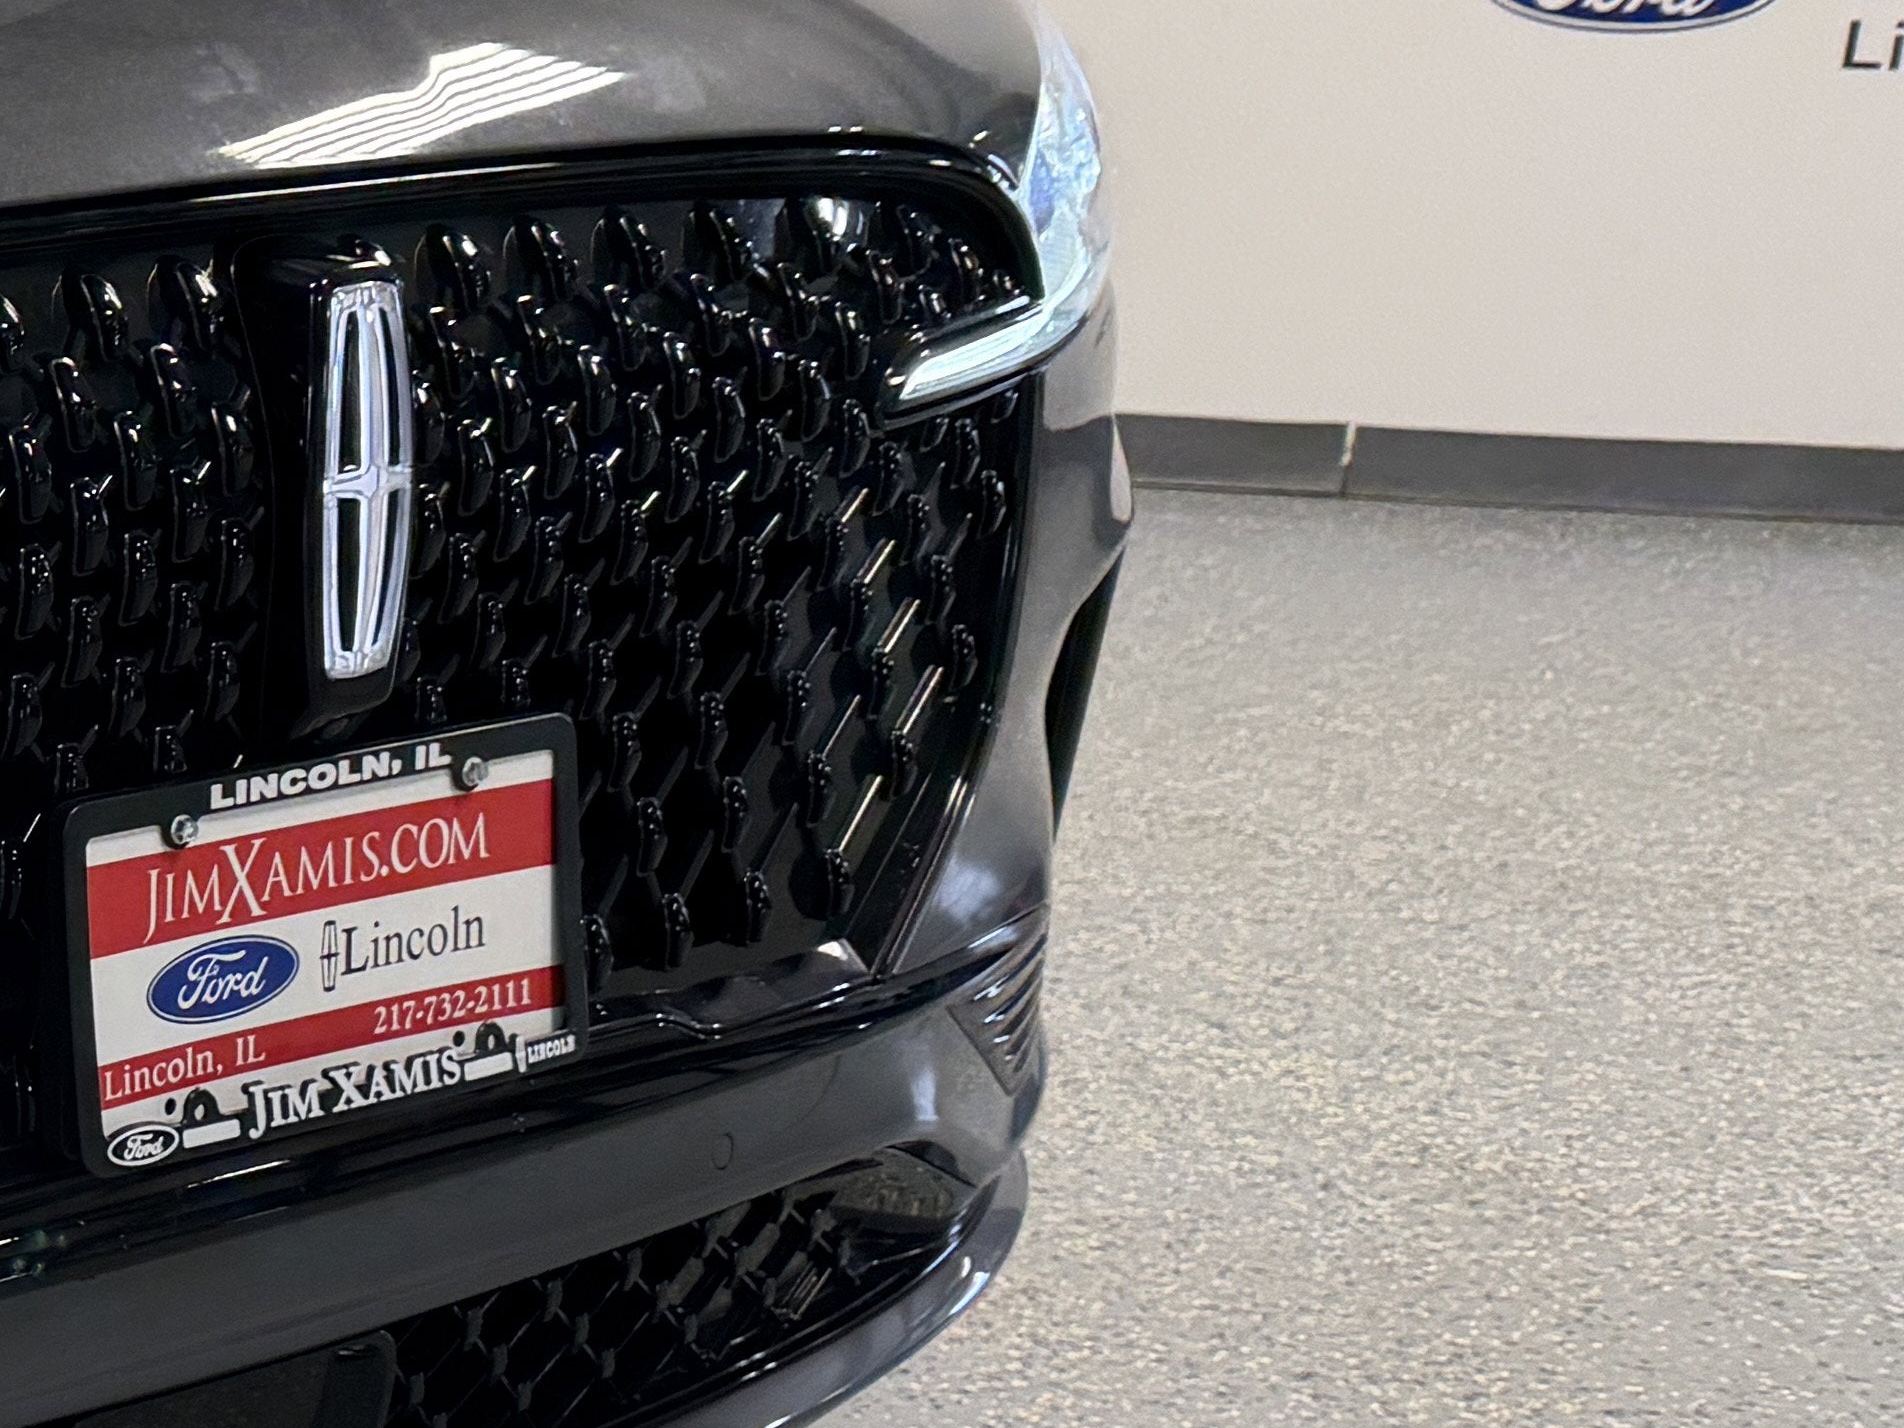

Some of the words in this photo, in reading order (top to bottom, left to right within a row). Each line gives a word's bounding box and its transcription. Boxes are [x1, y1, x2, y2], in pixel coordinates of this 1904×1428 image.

[209, 750, 404, 811] LINCOLN,
[414, 741, 452, 770] IL
[142, 812, 491, 945] JIMXAMIS.COM
[339, 904, 486, 977] Lincoln
[175, 949, 267, 1011] Ford
[373, 977, 533, 1035] 217-732-2111
[103, 1046, 224, 1101] Lincoln,
[235, 1034, 267, 1067] IL
[248, 1080, 327, 1140] JIM
[330, 1048, 462, 1114] XAMIS
[123, 1132, 165, 1161] Ford
